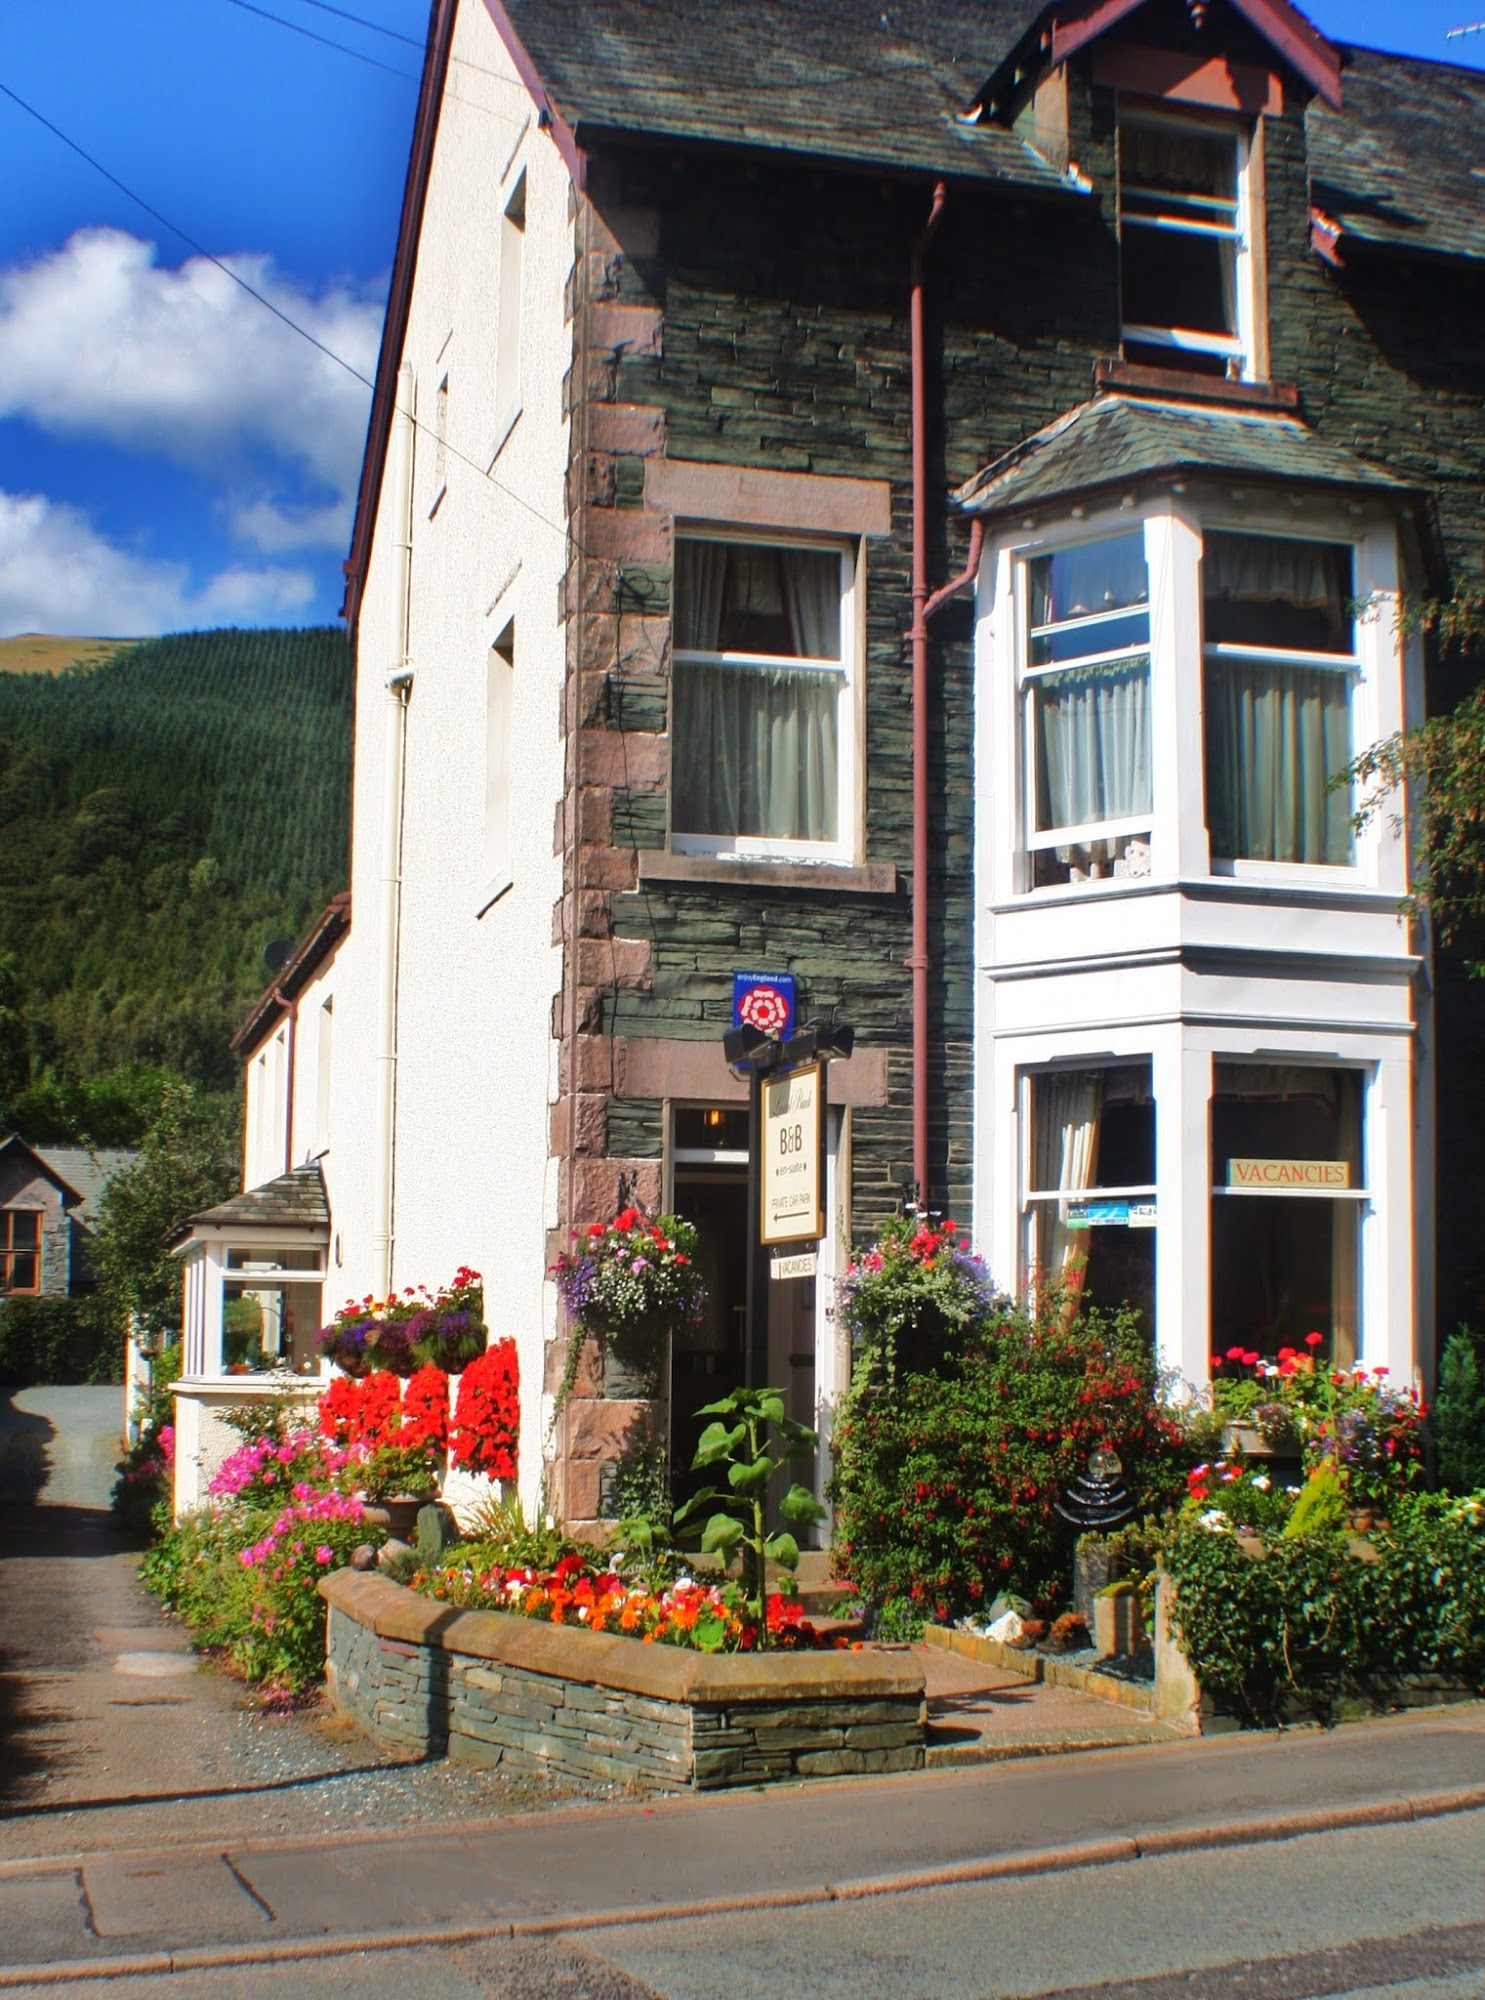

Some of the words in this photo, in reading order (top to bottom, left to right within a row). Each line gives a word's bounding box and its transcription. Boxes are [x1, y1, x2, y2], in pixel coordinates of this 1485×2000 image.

[737, 973, 792, 983] enjoyEngland.com
[780, 1124, 802, 1155] B&B
[780, 1162, 803, 1176] en-suite
[1236, 1163, 1345, 1183] VACANCIES
[771, 1196, 788, 1209] PRIVATE
[789, 1195, 798, 1207] CAR
[782, 1258, 813, 1274] VACANCIES
